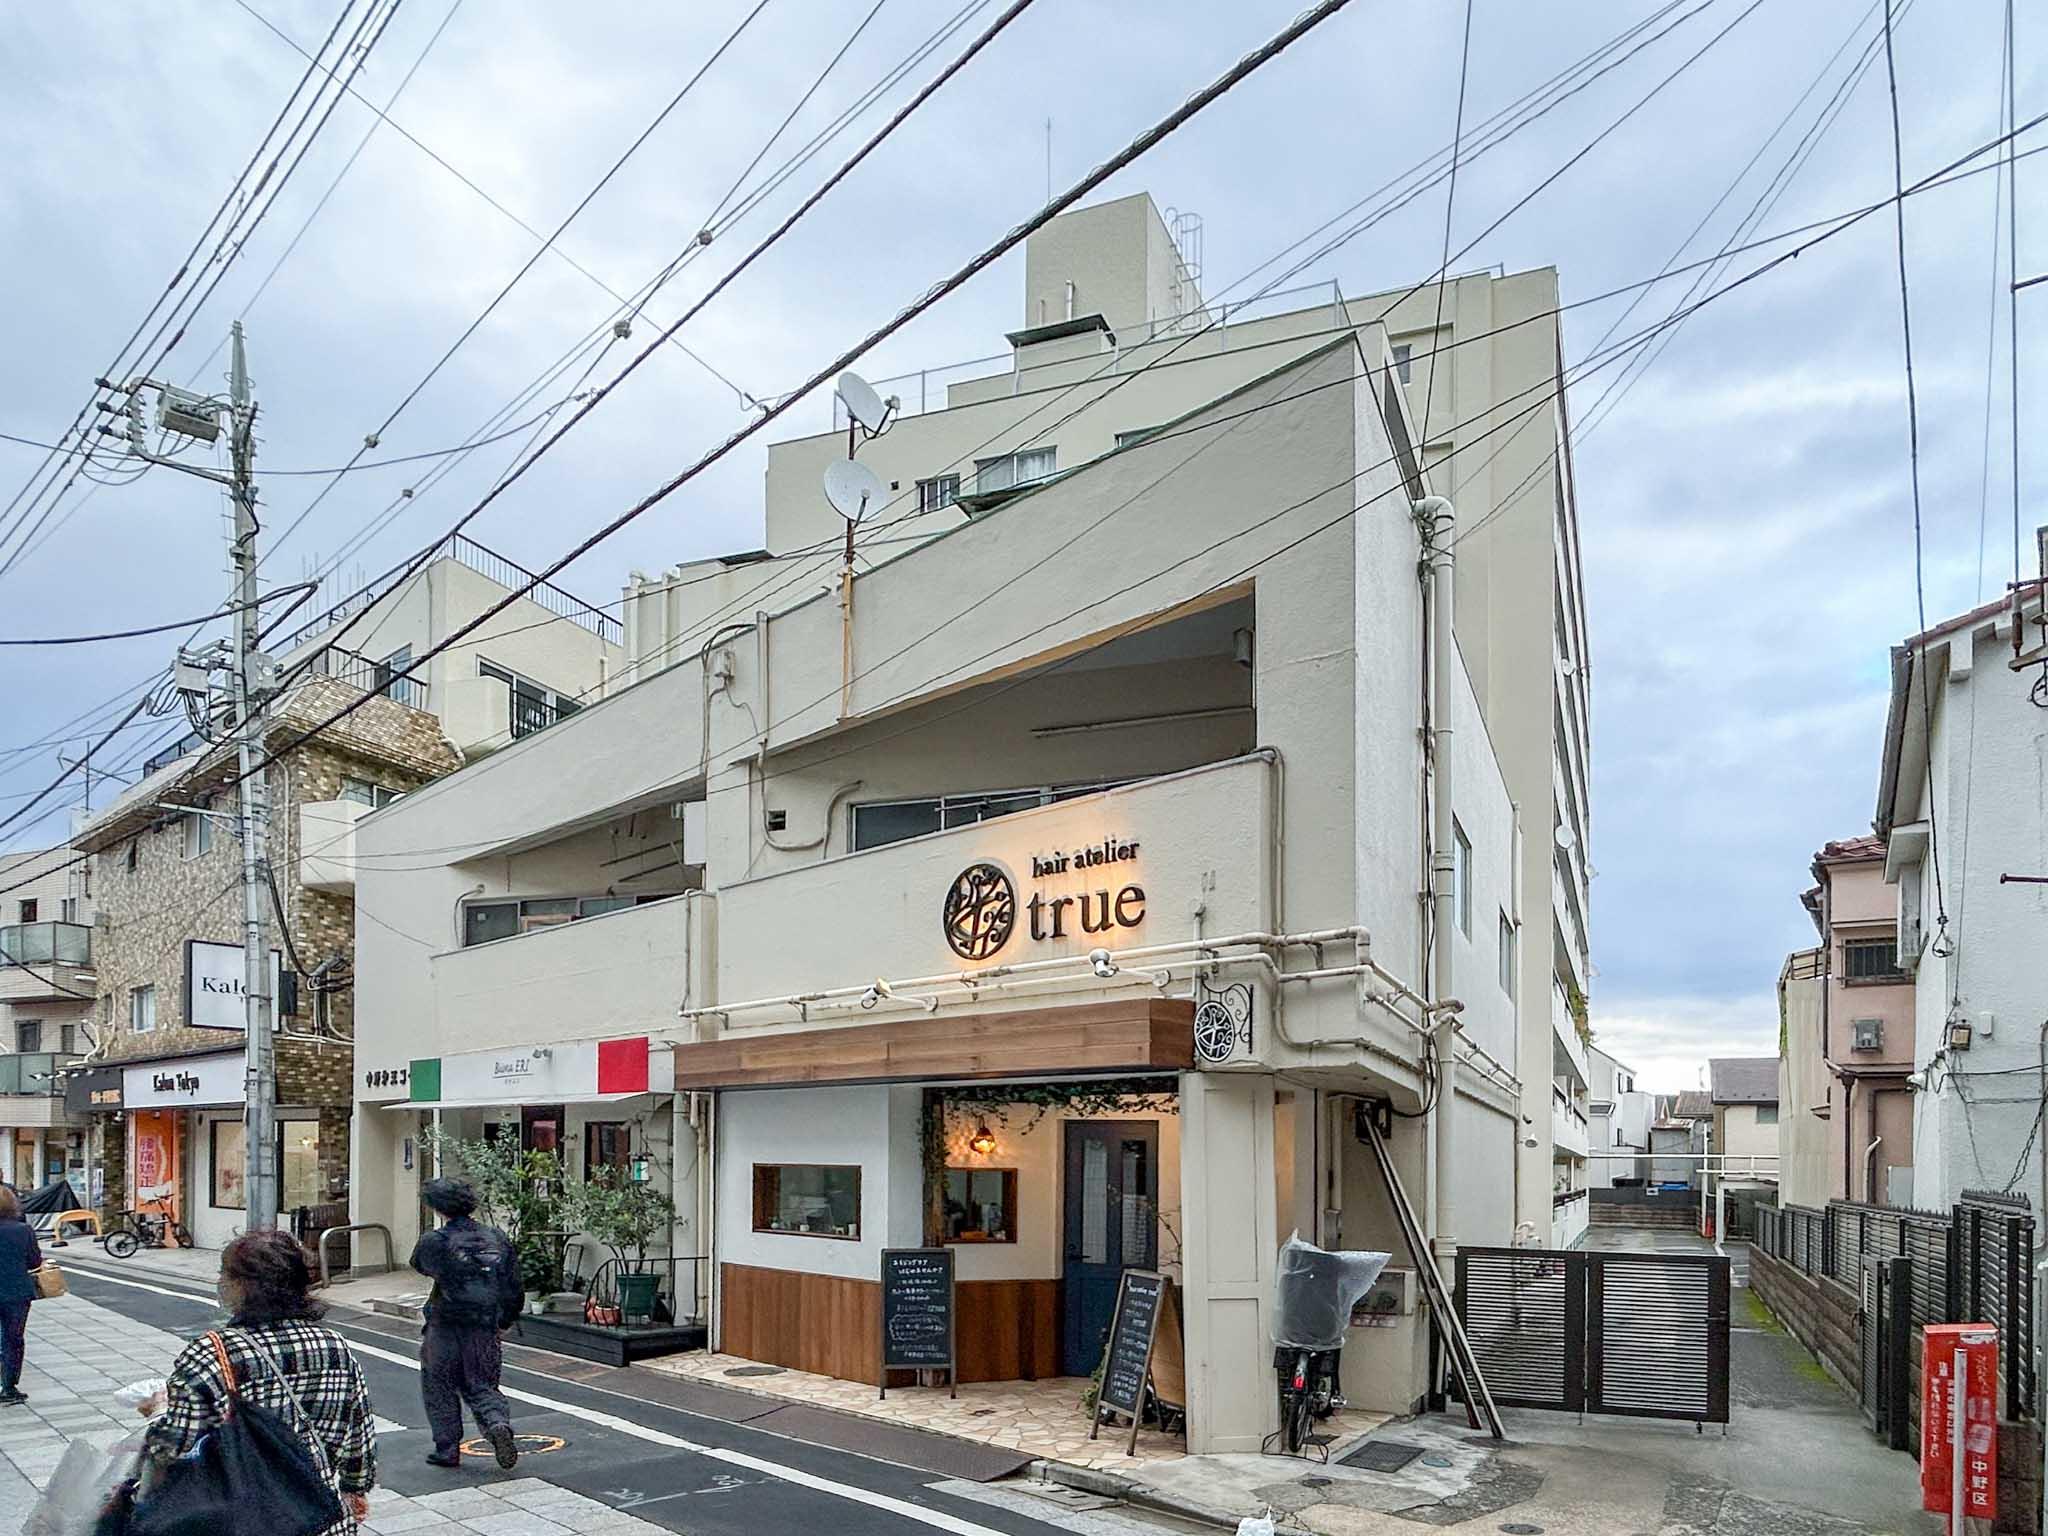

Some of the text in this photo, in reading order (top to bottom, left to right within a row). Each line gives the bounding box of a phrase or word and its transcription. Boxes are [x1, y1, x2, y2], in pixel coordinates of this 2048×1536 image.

[1032, 838, 1140, 879] hair atelier
[1027, 886, 1145, 941] true
[1972, 1460, 1988, 1506] 中野区
